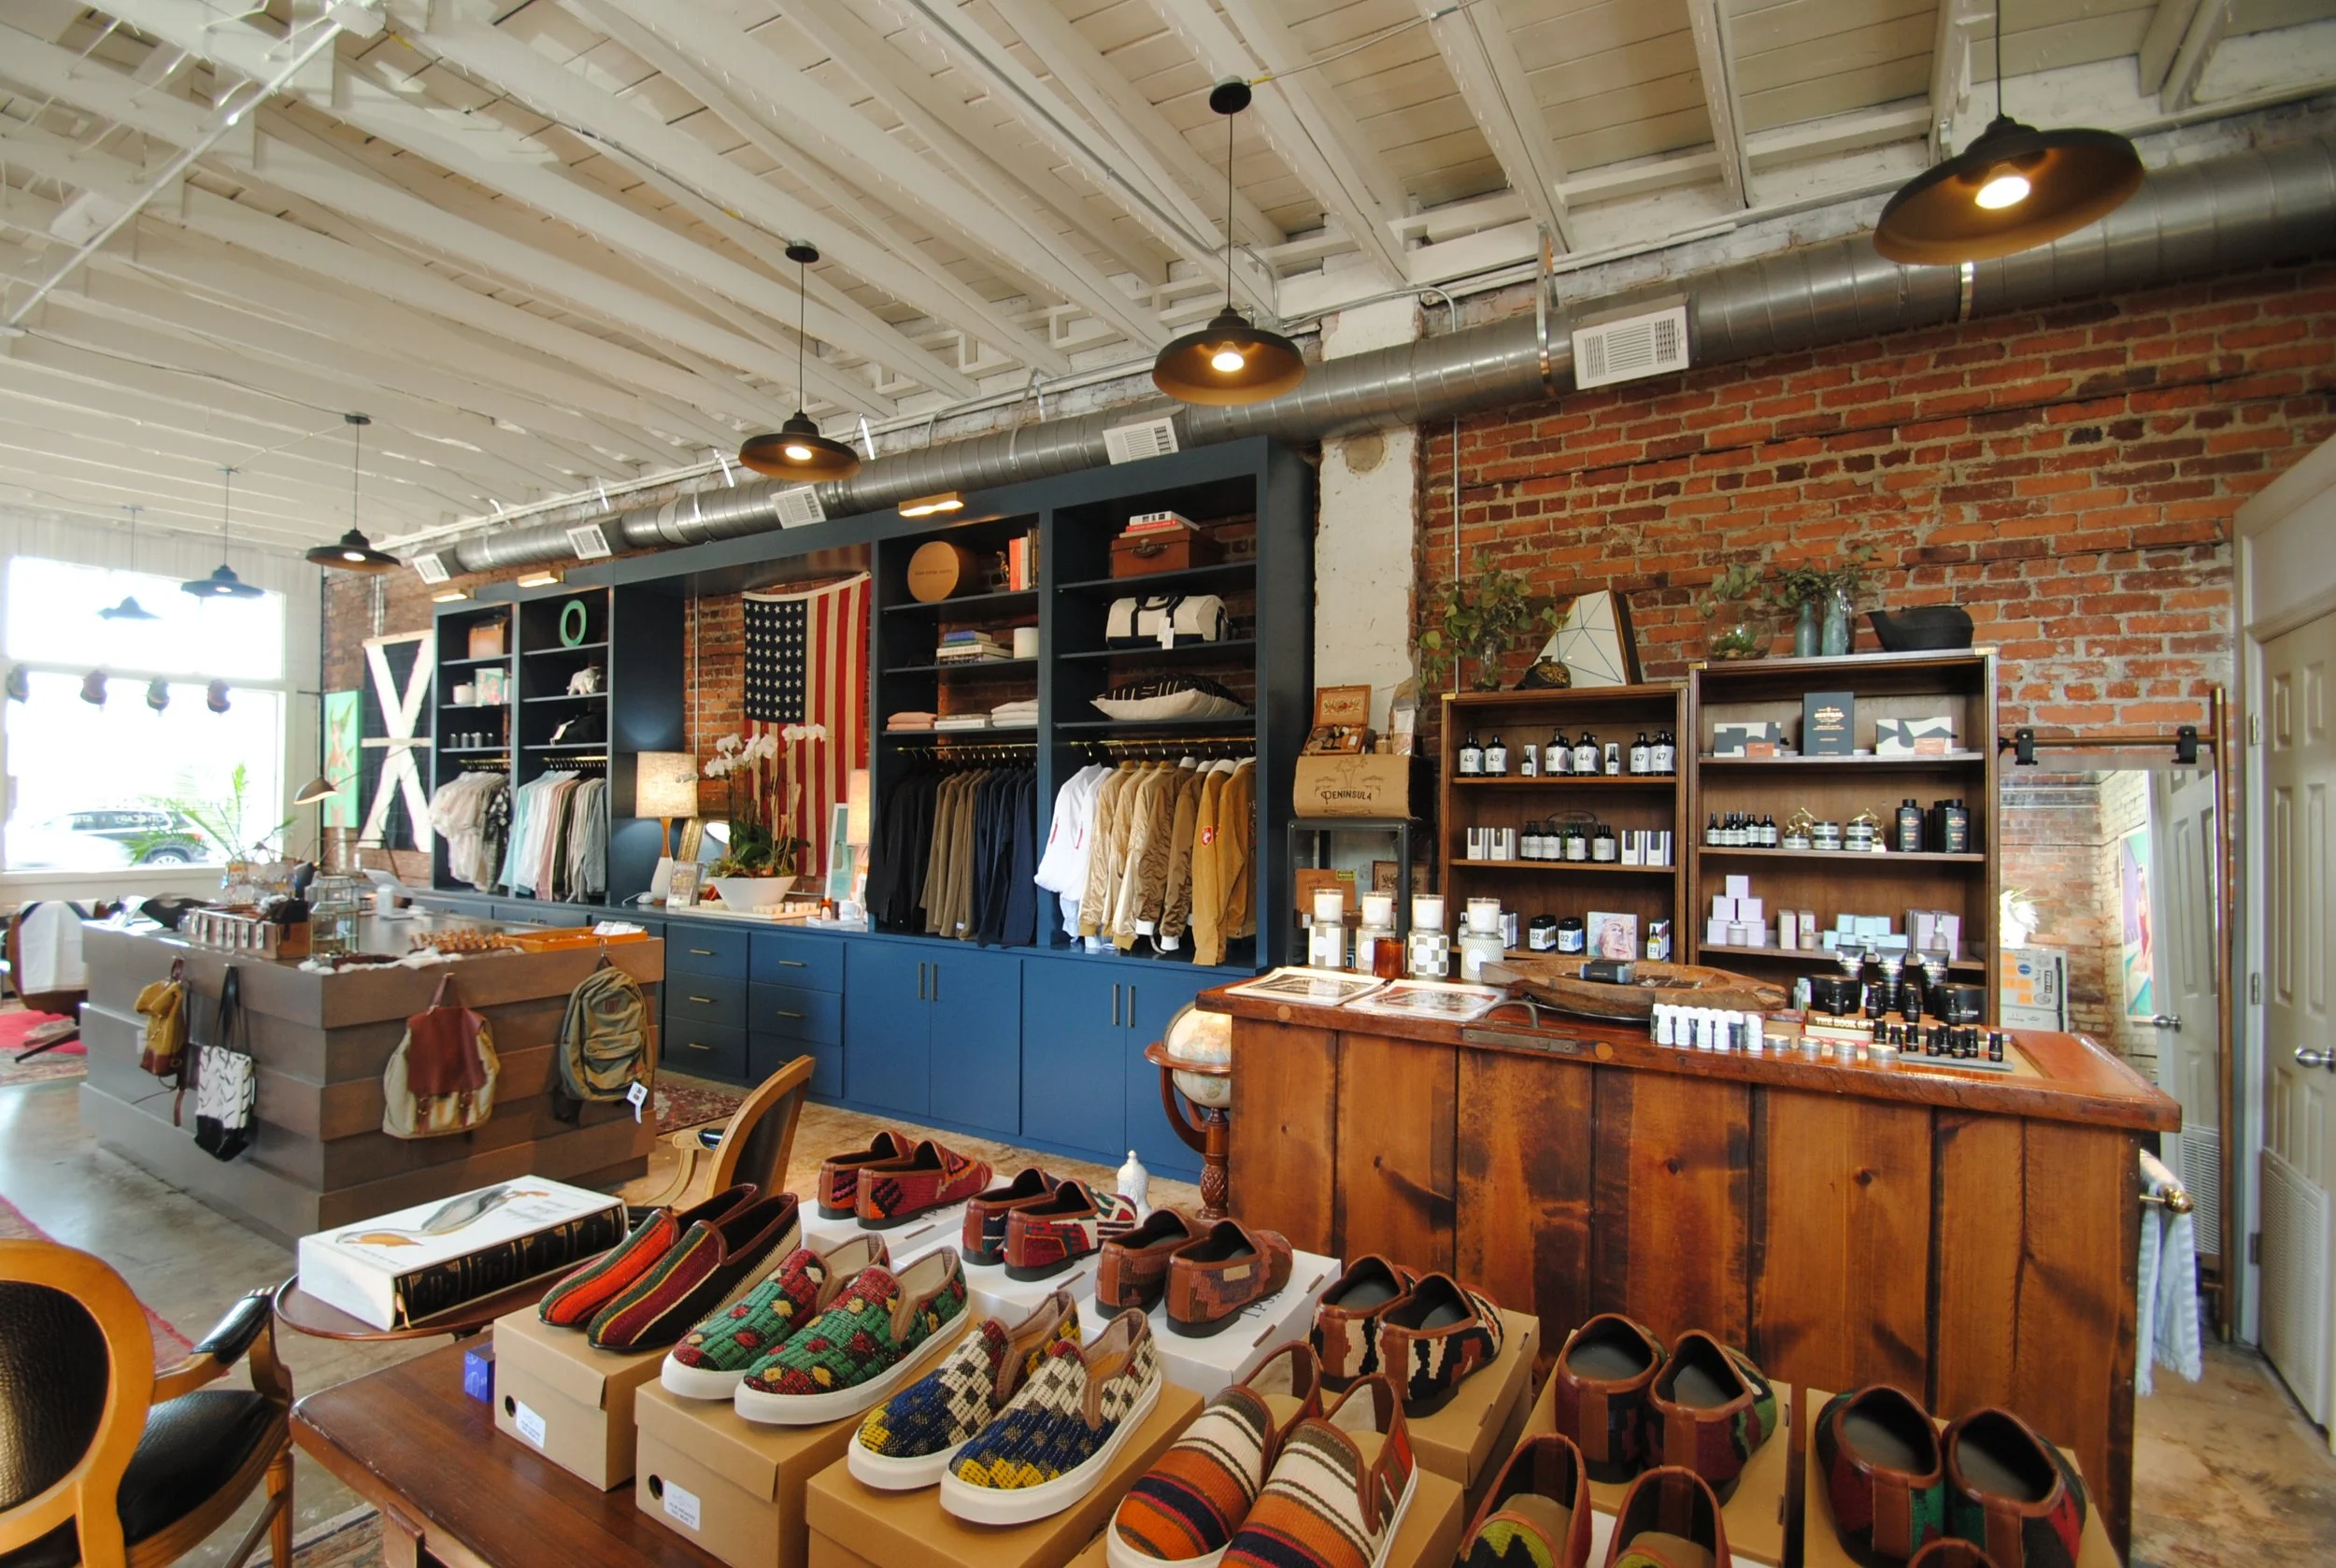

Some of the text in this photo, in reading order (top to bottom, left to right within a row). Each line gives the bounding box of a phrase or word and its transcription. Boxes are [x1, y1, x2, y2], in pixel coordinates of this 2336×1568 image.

[1463, 755, 1474, 763] 45
[1634, 754, 1645, 763] 47
[1656, 752, 1667, 761] 47
[1320, 790, 1373, 805] PENINSULA
[1531, 933, 1541, 941] 02
[1815, 1017, 1833, 1026] THE
[1834, 1018, 1857, 1029] BOOK
